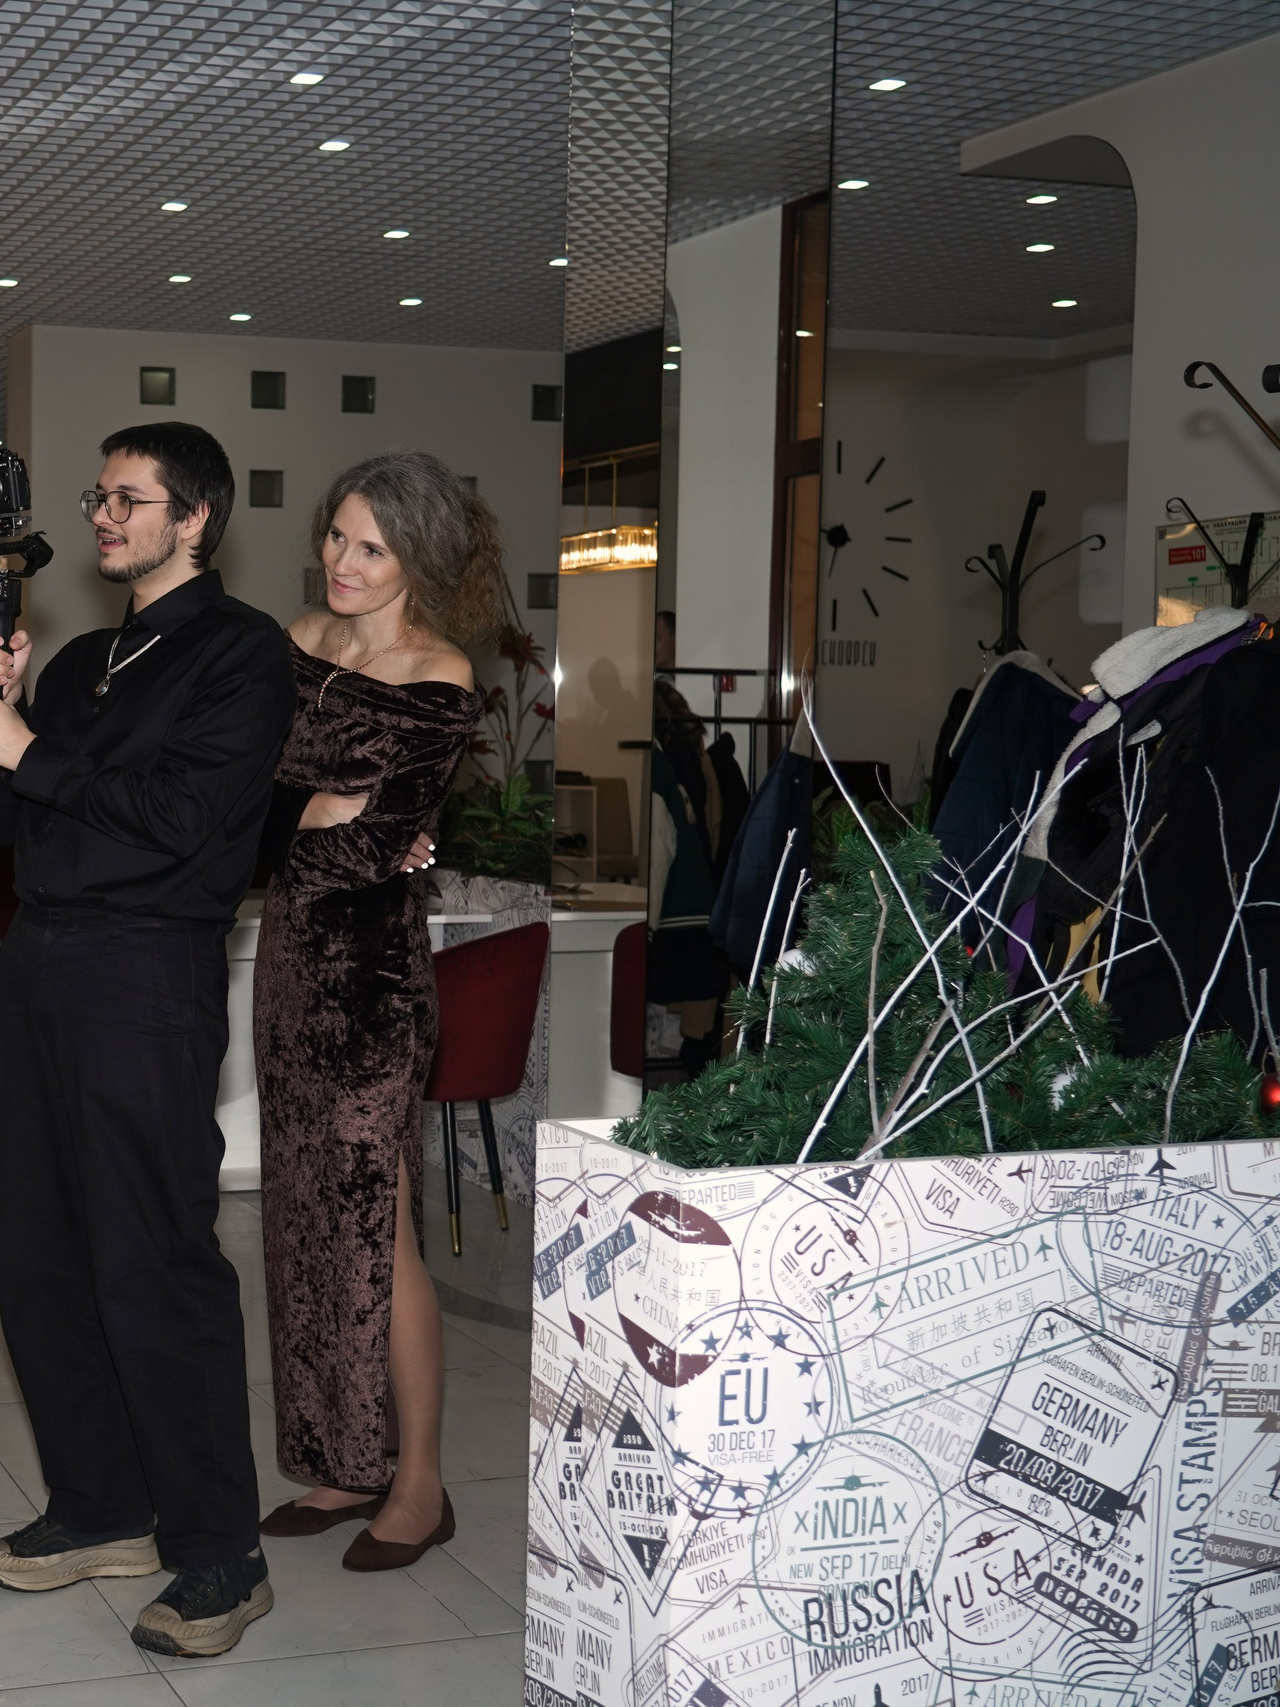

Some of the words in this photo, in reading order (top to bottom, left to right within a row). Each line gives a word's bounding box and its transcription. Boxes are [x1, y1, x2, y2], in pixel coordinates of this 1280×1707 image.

[1191, 548, 1205, 561] 101
[924, 1178, 962, 1220] VISA
[1177, 1172, 1214, 1190] ARRIVAL
[1150, 1188, 1209, 1231] ITALY
[794, 1224, 854, 1301] USA
[1101, 1218, 1233, 1278] 18-AUG-2017
[897, 1240, 1030, 1314] ARRIVED
[642, 1295, 679, 1334] CHINA
[905, 1287, 1036, 1352] 新加坡共和国
[961, 1345, 982, 1369] of
[718, 1367, 769, 1427] EU
[918, 1397, 964, 1427] WELCOME
[1079, 1367, 1151, 1413] BERLIN-SCHÖNEFELD
[1031, 1381, 1129, 1448] GERMANY
[618, 1452, 651, 1464] ARRIVED
[707, 1433, 726, 1453] 30
[729, 1430, 756, 1452] DEC
[760, 1429, 776, 1449] 17
[708, 1450, 775, 1467] VISA-FREE
[892, 1408, 974, 1469] FRANCE
[1039, 1424, 1094, 1468] BERLIN
[1176, 1379, 1224, 1513] STAMPS
[611, 1470, 664, 1495] GREAT
[999, 1443, 1105, 1511] 20/08/2017
[789, 1562, 814, 1580] NEW
[818, 1553, 853, 1582] SEP
[859, 1551, 879, 1577] 17
[881, 1553, 911, 1571] DELHI
[1070, 1545, 1145, 1595] CANADA
[1167, 1521, 1210, 1600] VISA
[1205, 1538, 1254, 1561] Republic
[694, 1568, 729, 1595] VISA
[953, 1548, 1032, 1610] USA
[1052, 1556, 1087, 1583] SEP
[1096, 1581, 1142, 1615] 2017
[803, 1568, 931, 1647] RUSSIA
[1039, 1577, 1132, 1638] DEPARTED
[1210, 1608, 1255, 1632] FLUGHAFEN
[807, 1617, 934, 1677] IMMIGRATION
[901, 1673, 930, 1697] 2017
